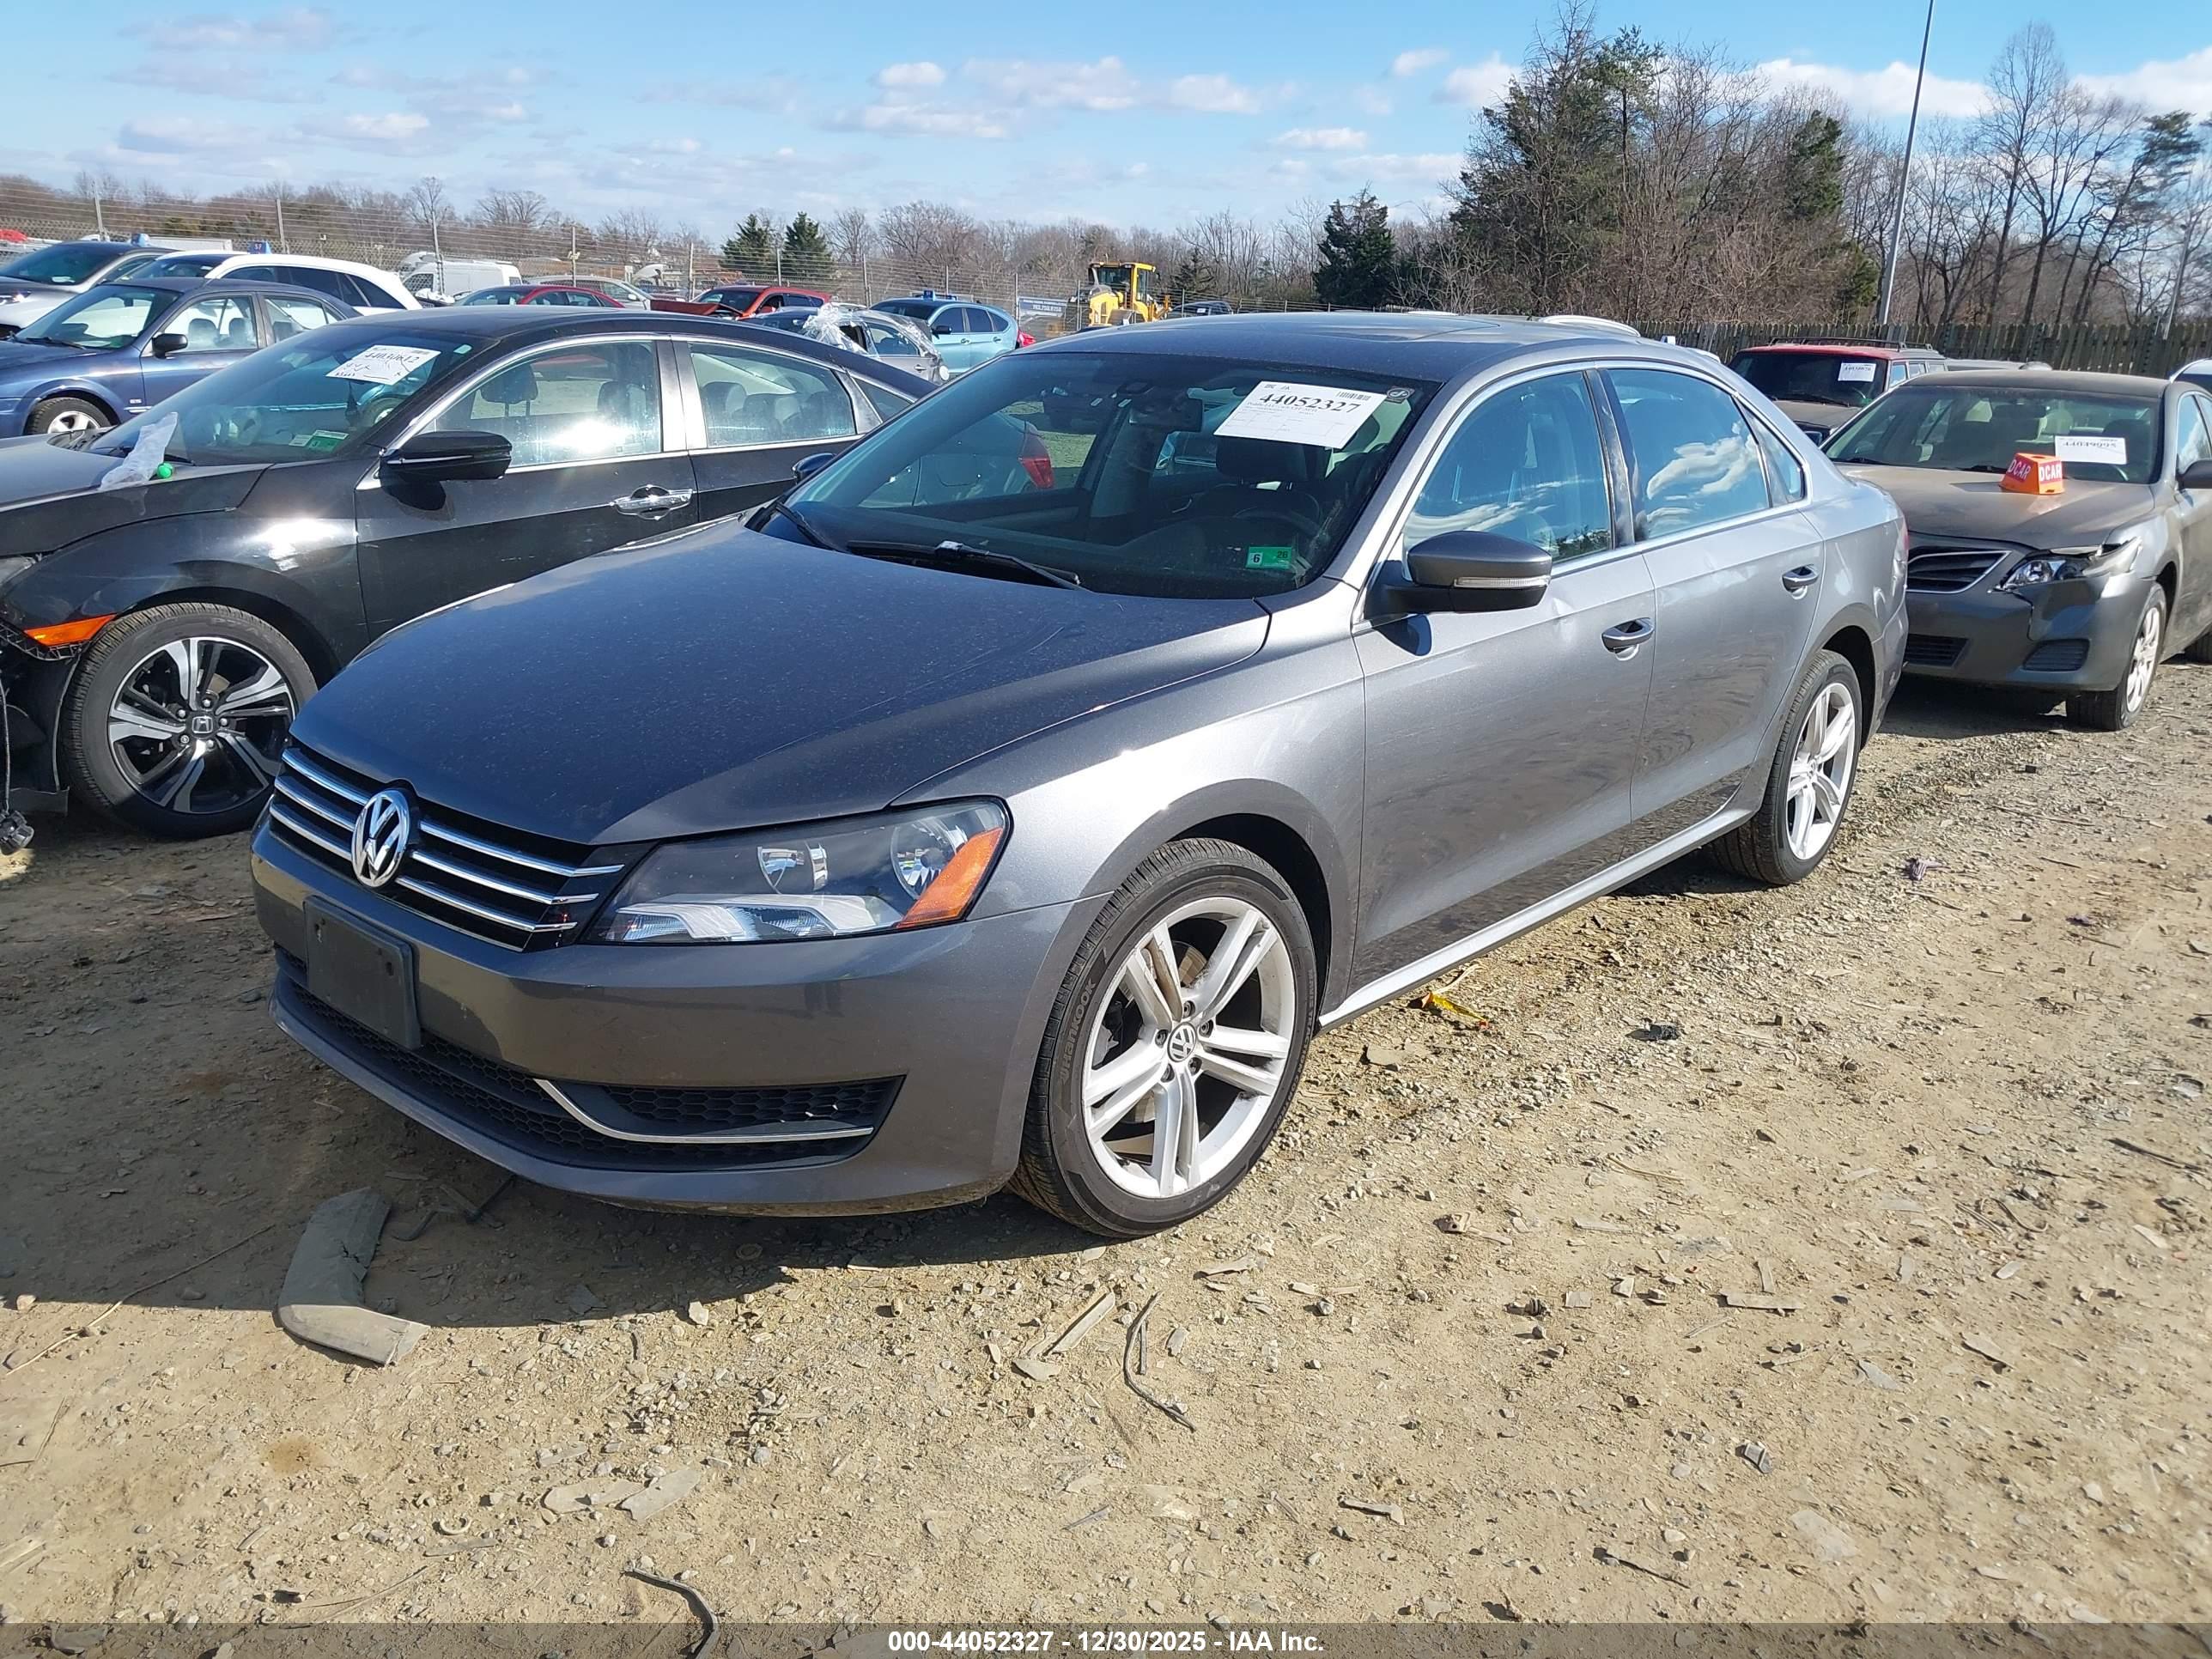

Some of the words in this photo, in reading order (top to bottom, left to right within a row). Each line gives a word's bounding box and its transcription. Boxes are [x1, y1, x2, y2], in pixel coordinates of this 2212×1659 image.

[1260, 393, 1361, 413] 44052327
[2008, 459, 2031, 480] DCAR
[2039, 464, 2062, 481] DCAR
[1254, 554, 1260, 563] 6
[1277, 550, 1288, 559] 26
